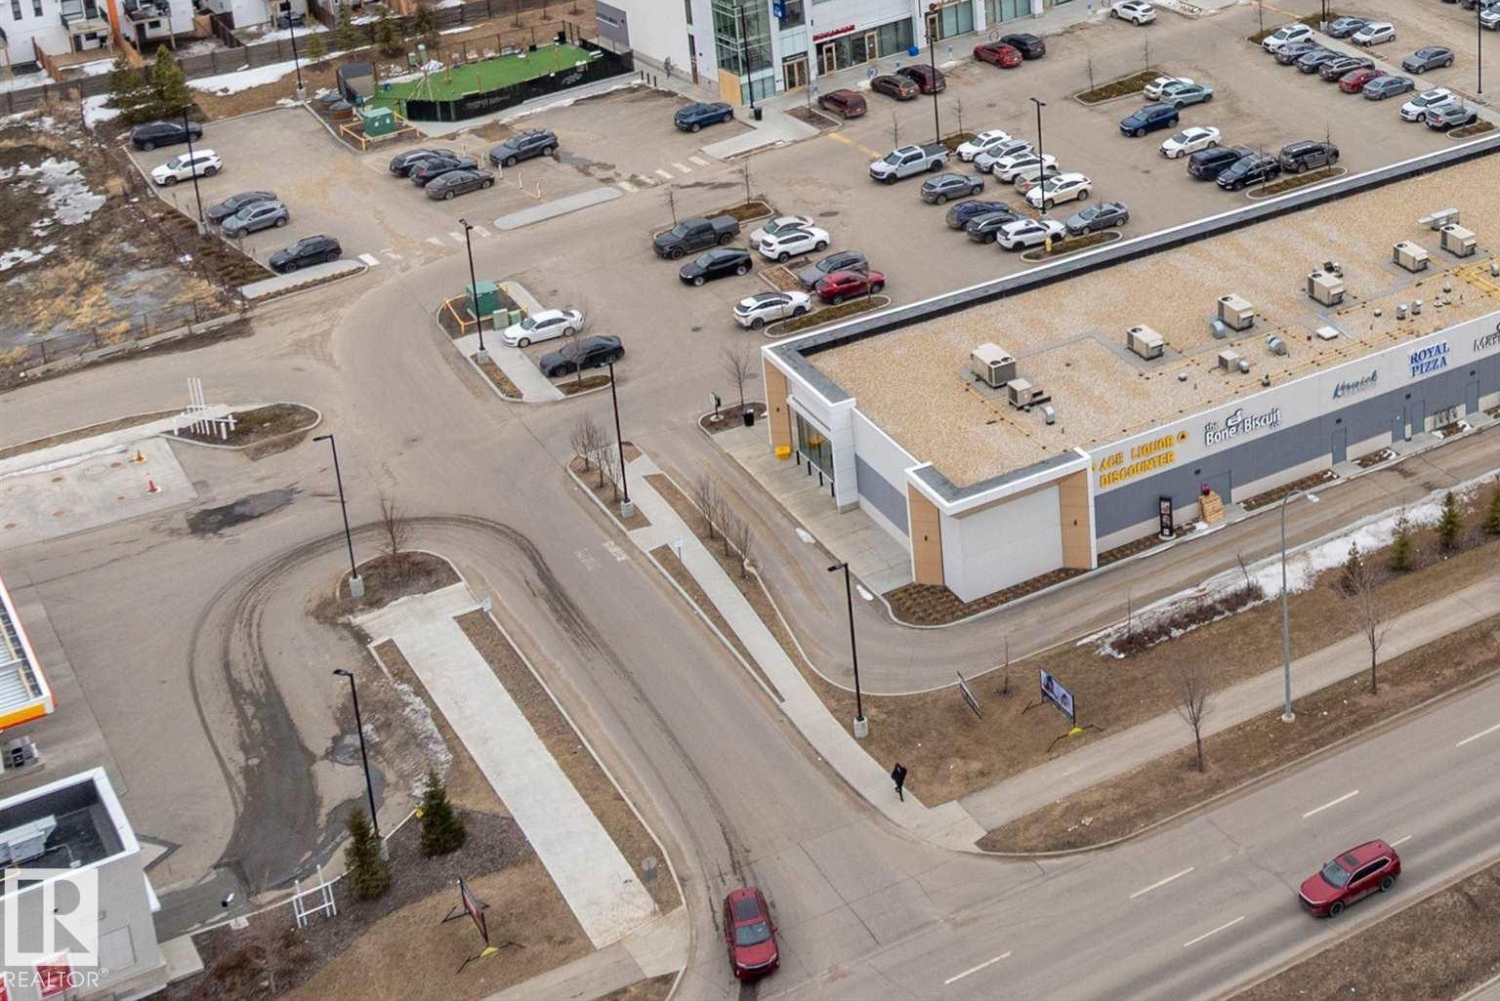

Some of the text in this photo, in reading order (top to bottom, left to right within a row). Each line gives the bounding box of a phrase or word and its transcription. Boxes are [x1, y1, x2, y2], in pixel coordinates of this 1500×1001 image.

[1409, 341, 1450, 366] ROYAL
[1411, 355, 1448, 377] PIZZA
[1205, 425, 1237, 447] Bone
[1243, 406, 1281, 434] Biscuit
[1099, 451, 1176, 488] DISCOUNTER
[1100, 436, 1174, 471] ACE LIQUOR
